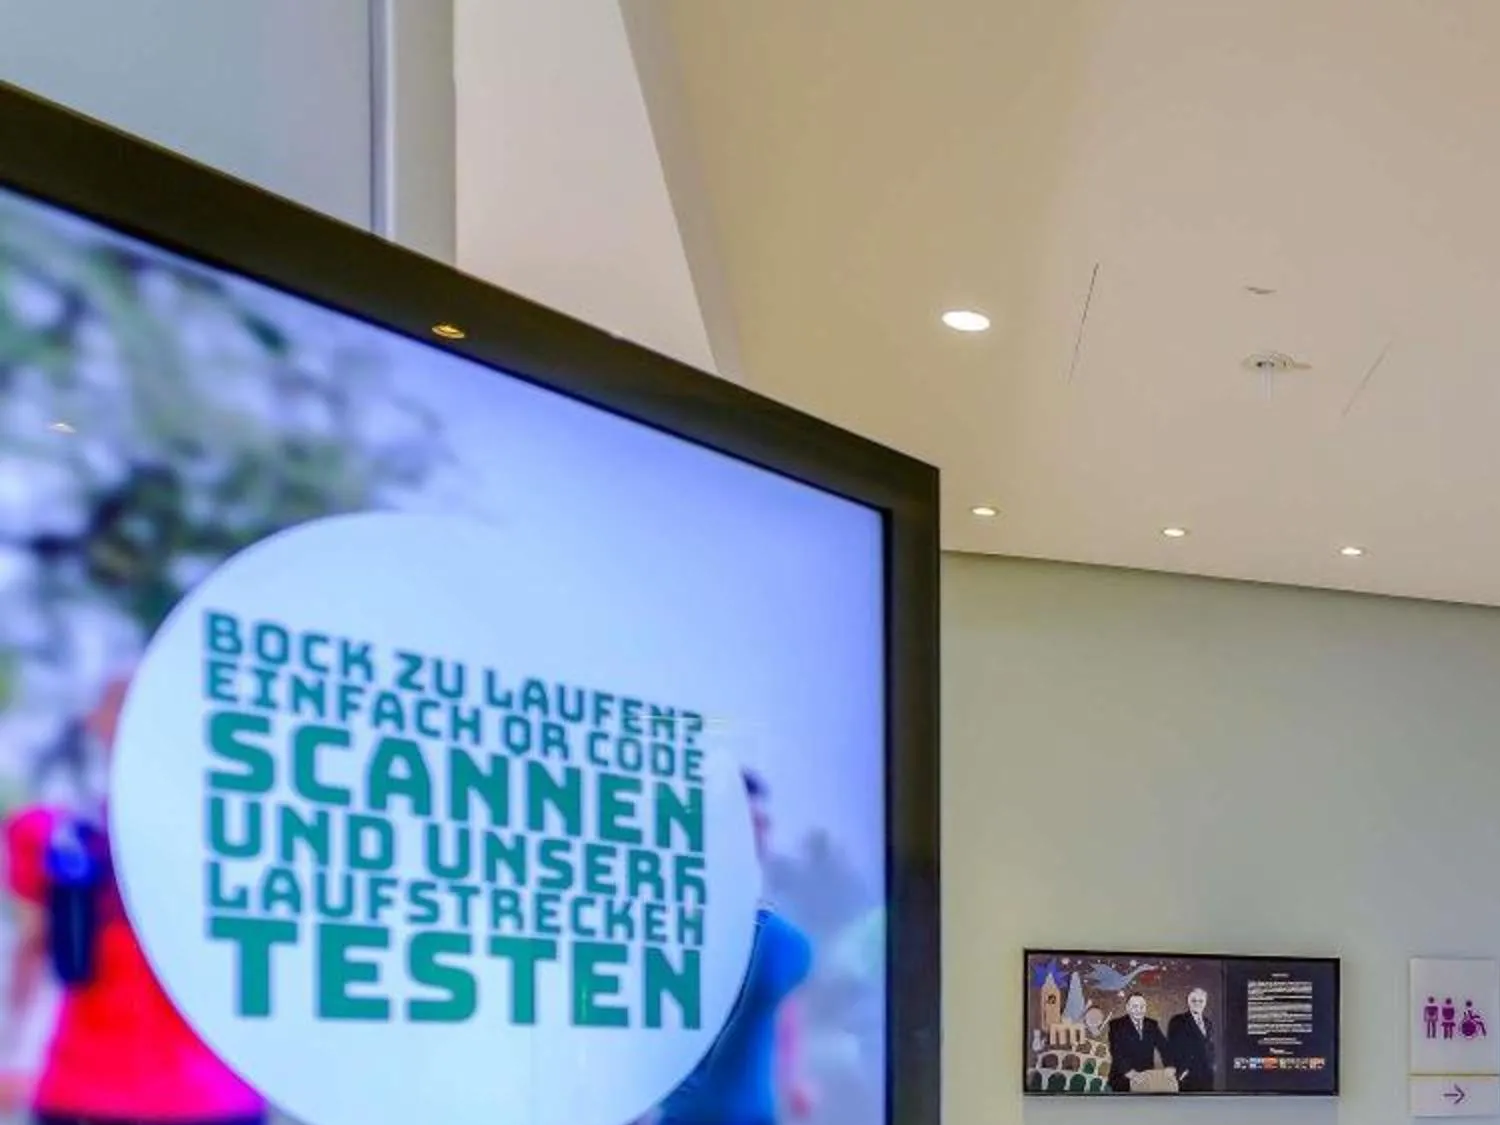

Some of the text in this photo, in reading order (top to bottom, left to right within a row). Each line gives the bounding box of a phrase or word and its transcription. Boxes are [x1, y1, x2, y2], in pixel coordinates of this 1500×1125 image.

[206, 611, 703, 743] BOCK ZU LAUFEN?
[206, 659, 703, 782] EINFACH QR CODE
[206, 710, 704, 853] SCANNEN
[209, 796, 395, 871] UND
[208, 915, 702, 1030] TESTEN
